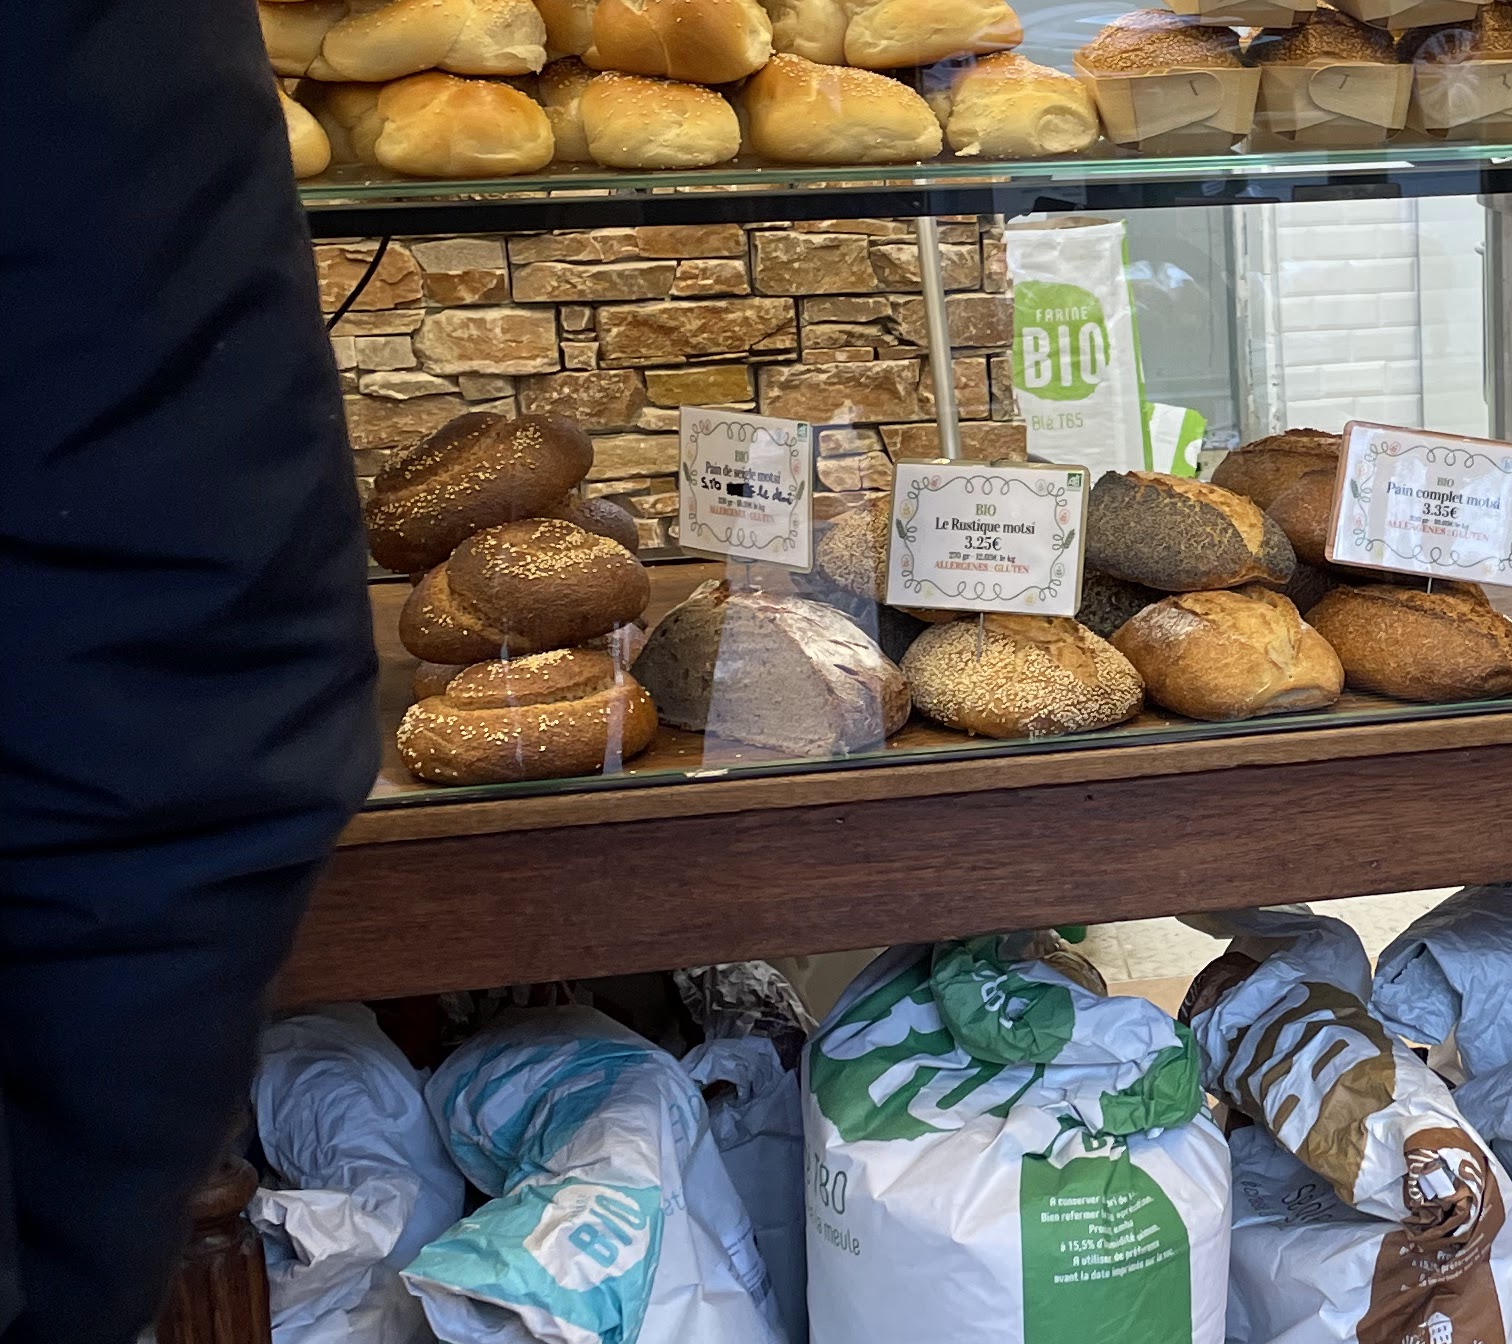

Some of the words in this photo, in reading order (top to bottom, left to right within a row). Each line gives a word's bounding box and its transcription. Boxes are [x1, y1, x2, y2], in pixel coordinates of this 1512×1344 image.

[1035, 306, 1089, 323] FARINE
[1022, 322, 1107, 389] BIO
[1059, 412, 1084, 430] T65
[705, 460, 722, 476] Pain
[723, 464, 733, 477] de
[734, 465, 757, 482] seigle
[1436, 476, 1455, 488] BIO
[1386, 480, 1413, 496] Pain
[1416, 488, 1463, 505] complet
[1466, 494, 1501, 510] motsi
[976, 503, 997, 517] BIO
[1422, 502, 1460, 519] 3.35€
[935, 516, 950, 530] Le
[951, 517, 1001, 536] Rustique
[1003, 521, 1036, 535] motsi
[964, 535, 1002, 551] 3.25€
[994, 563, 1030, 574] GLUTEN
[1041, 1212, 1060, 1223] Bien
[1061, 1209, 1099, 1222] refermer
[568, 1193, 650, 1269] BIO
[824, 1222, 861, 1256] meule
[1068, 1239, 1095, 1253] 15,5%
[1054, 1271, 1078, 1283] avant
[1080, 1270, 1089, 1281] la
[1090, 1268, 1110, 1280] date
